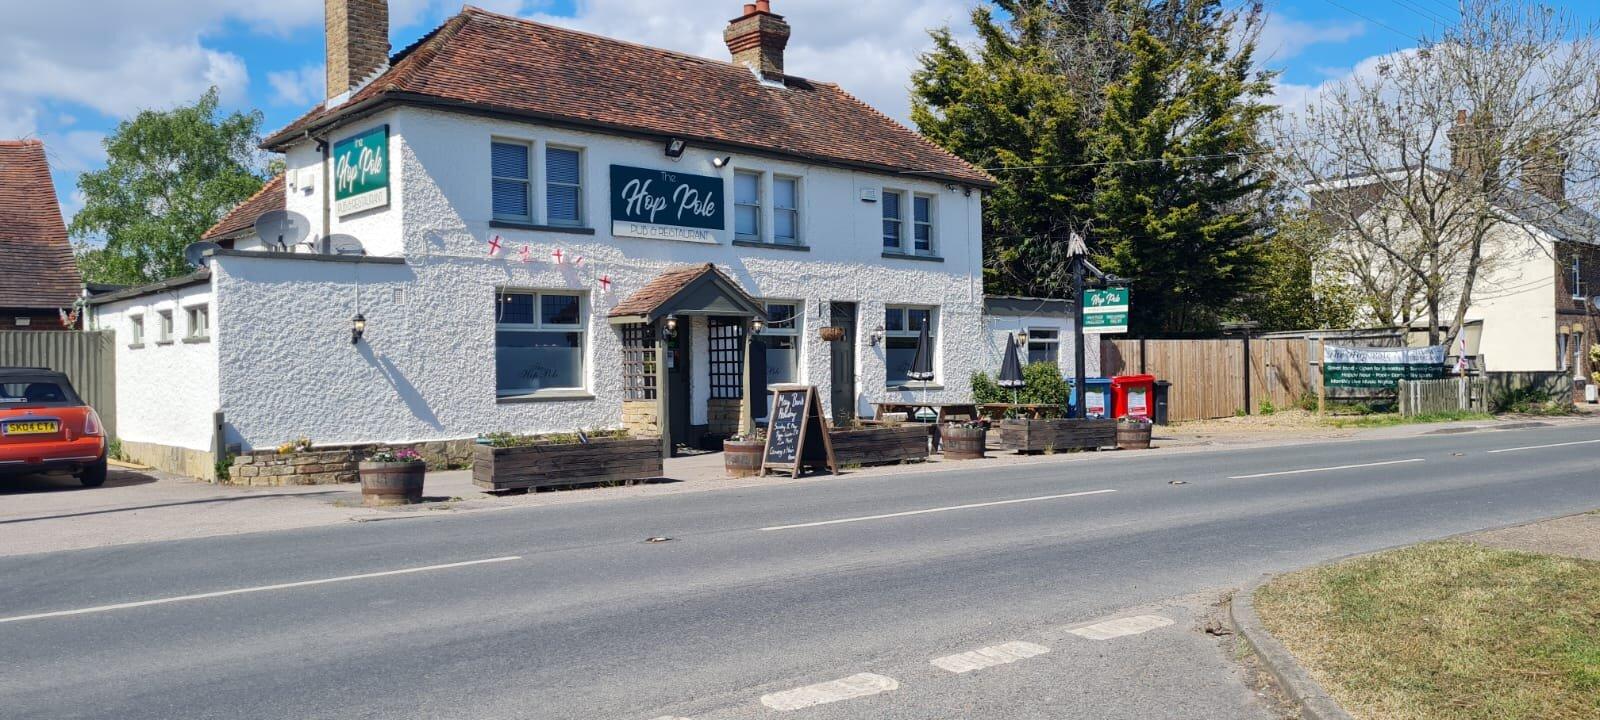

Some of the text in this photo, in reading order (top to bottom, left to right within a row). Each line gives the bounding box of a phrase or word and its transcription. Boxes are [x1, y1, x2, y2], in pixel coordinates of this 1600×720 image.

[336, 145, 382, 193] Hop Pole
[660, 171, 677, 183] The
[621, 178, 716, 223] Hop Pole
[630, 224, 648, 236] PUB
[658, 228, 708, 240] RESTAURANT
[778, 394, 791, 412] May
[10, 422, 55, 432] SK04 CTA
